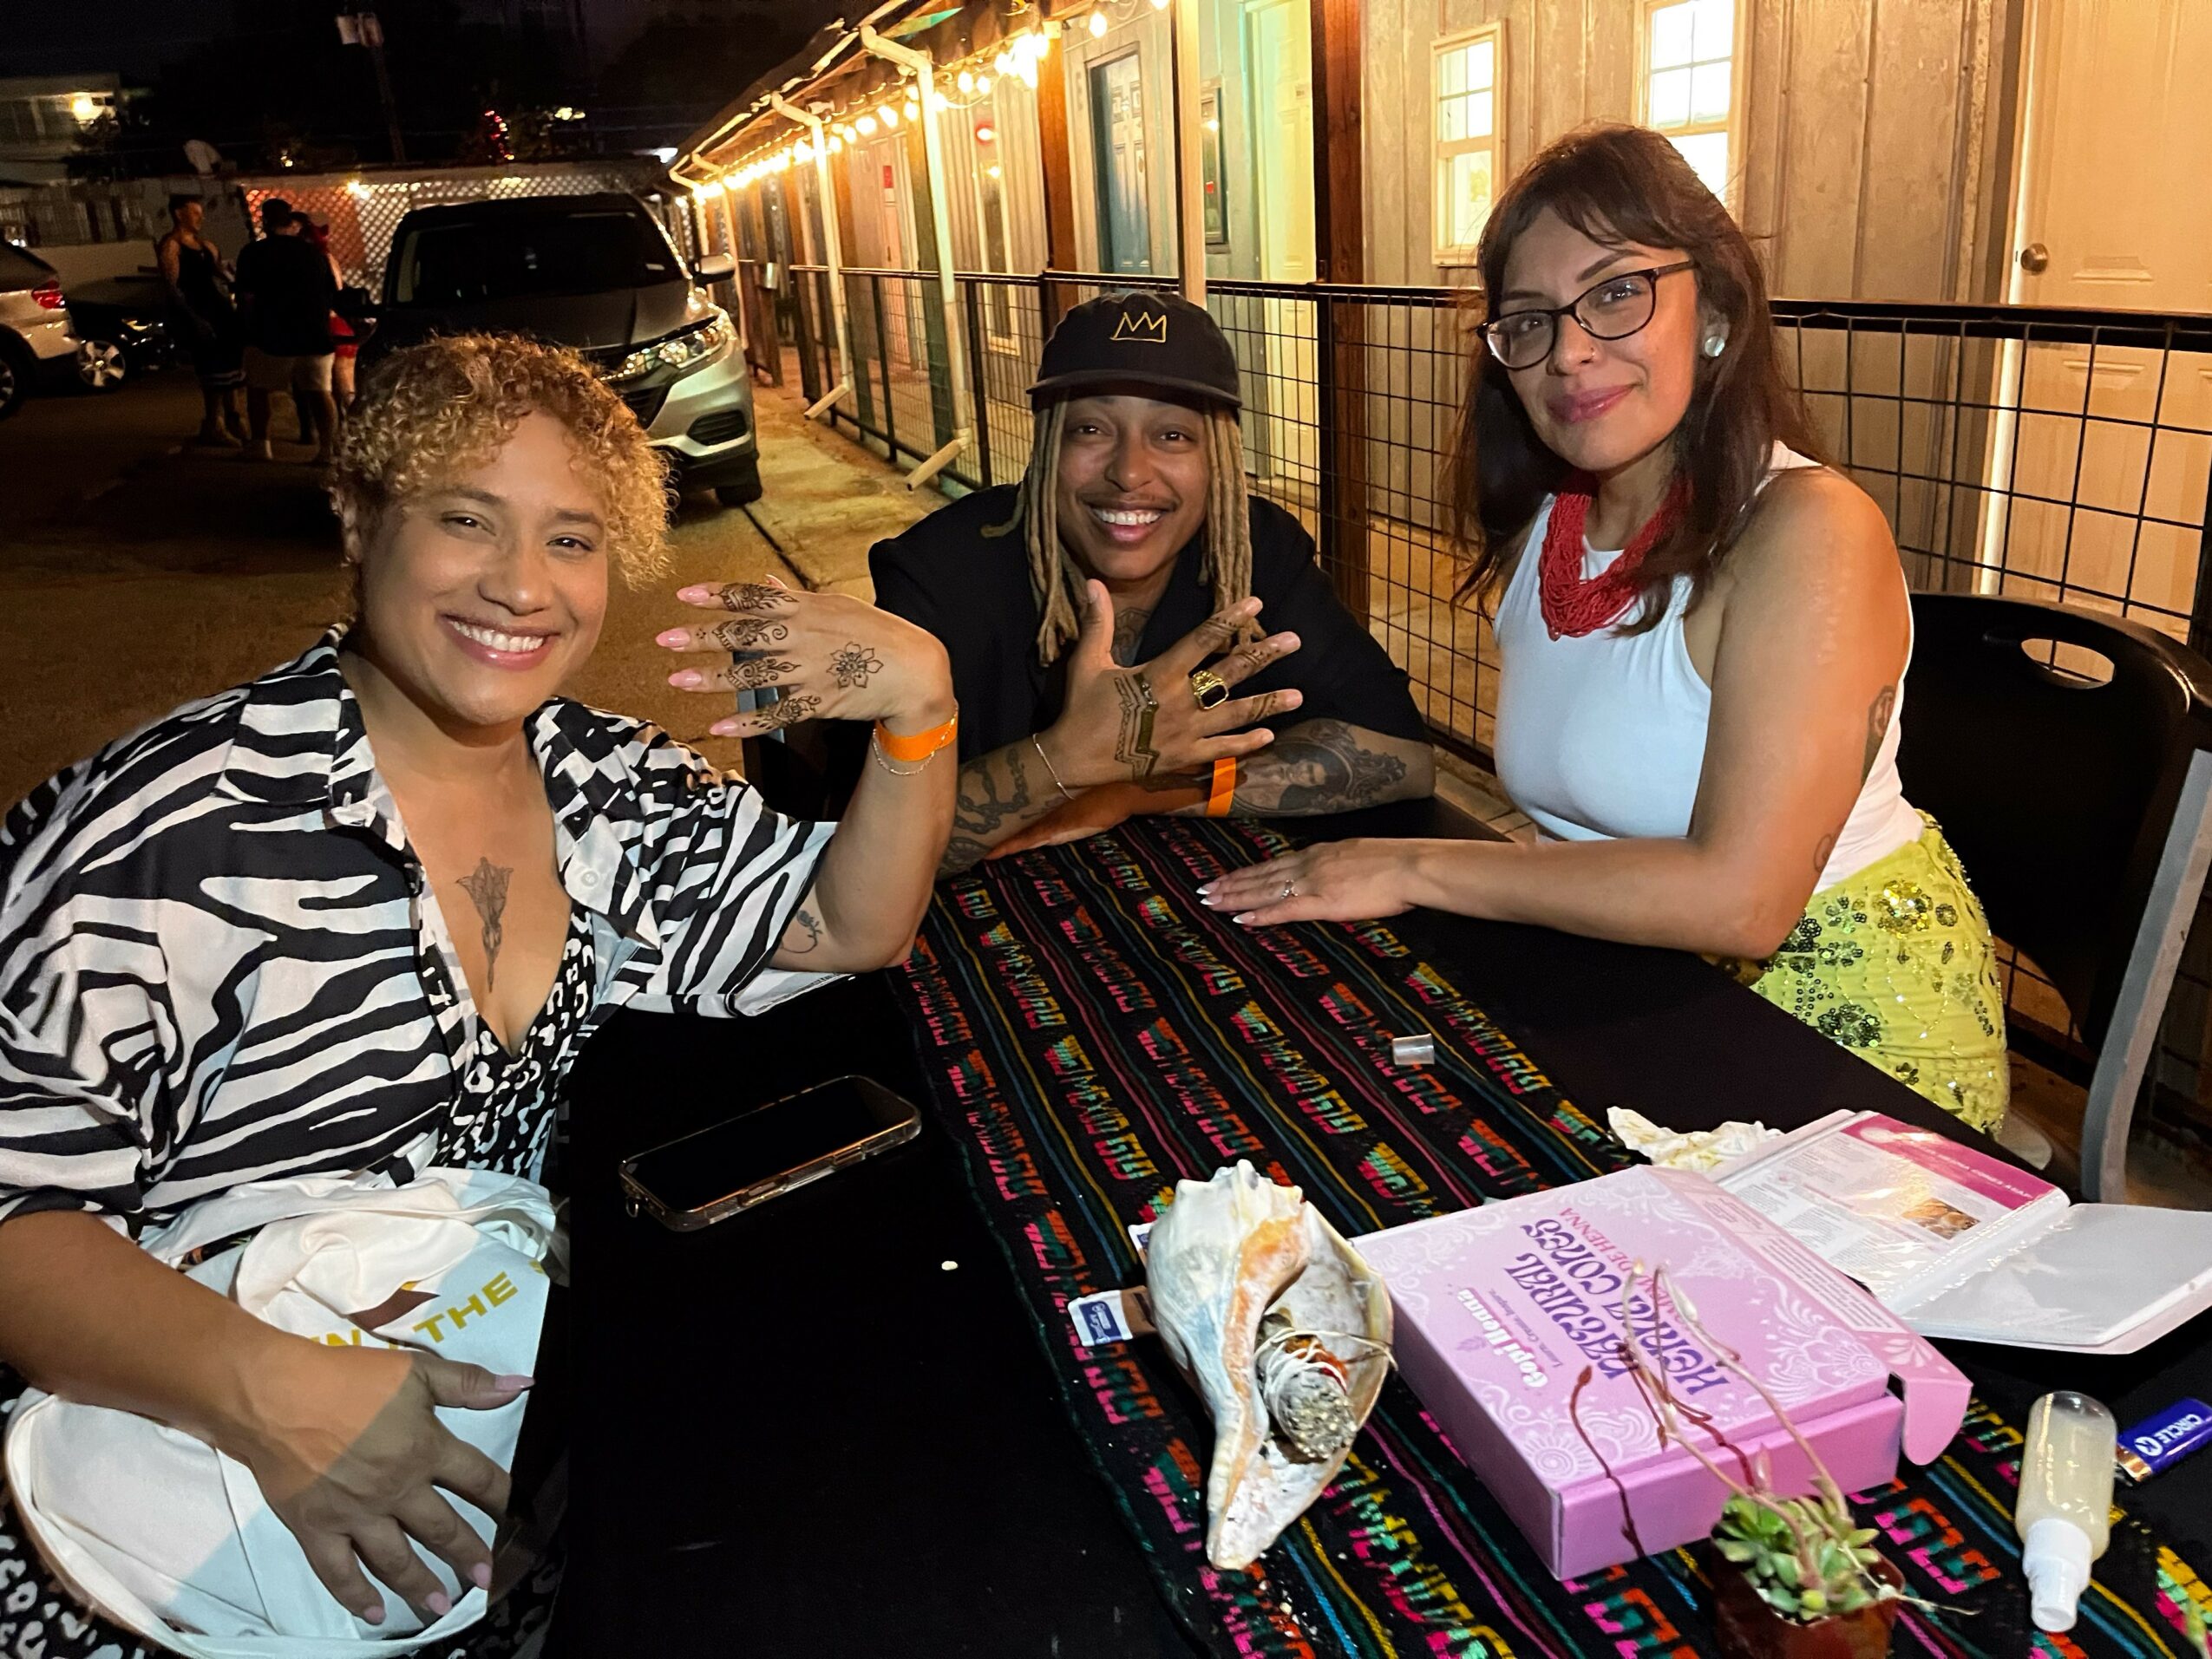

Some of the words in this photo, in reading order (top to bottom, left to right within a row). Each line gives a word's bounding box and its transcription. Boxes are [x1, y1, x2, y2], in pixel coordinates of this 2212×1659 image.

[1520, 1218, 1622, 1295] CONES
[1559, 1206, 1616, 1252] HENNA
[412, 1270, 519, 1343] THE
[1457, 1288, 1513, 1346] Henna
[1504, 1253, 1636, 1379] NATURAL
[1493, 1342, 1548, 1388] Gopi
[1602, 1295, 1731, 1395] HENNA
[2135, 1436, 2163, 1457] K
[2154, 1414, 2202, 1444] CIRCLE
